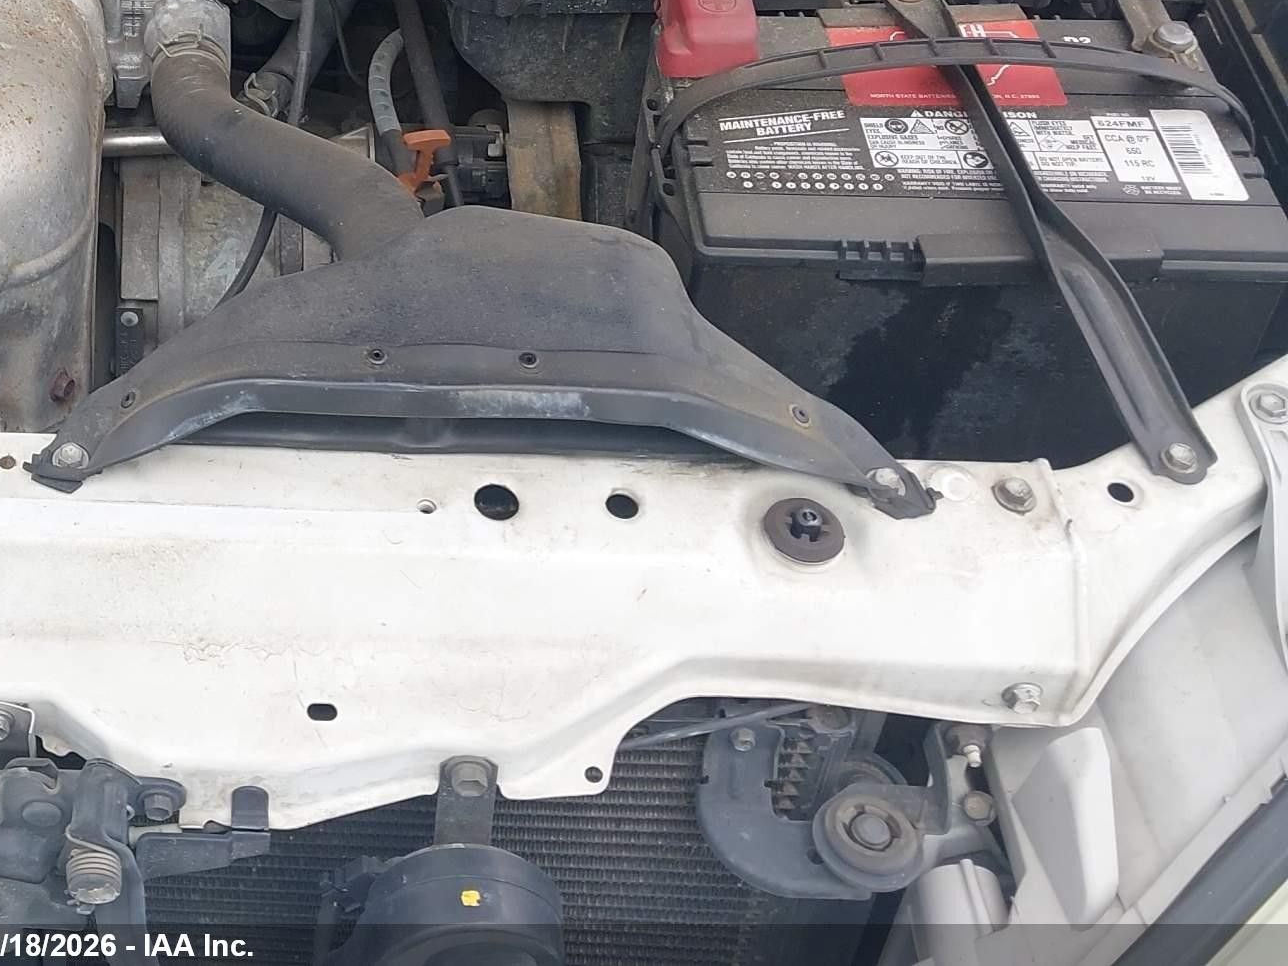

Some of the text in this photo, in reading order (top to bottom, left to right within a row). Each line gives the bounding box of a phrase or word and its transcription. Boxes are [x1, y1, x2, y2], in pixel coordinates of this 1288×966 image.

[719, 109, 846, 132] MAINTENANCE-FREE
[756, 121, 812, 137] BATTERY
[1104, 134, 1125, 143] CCA
